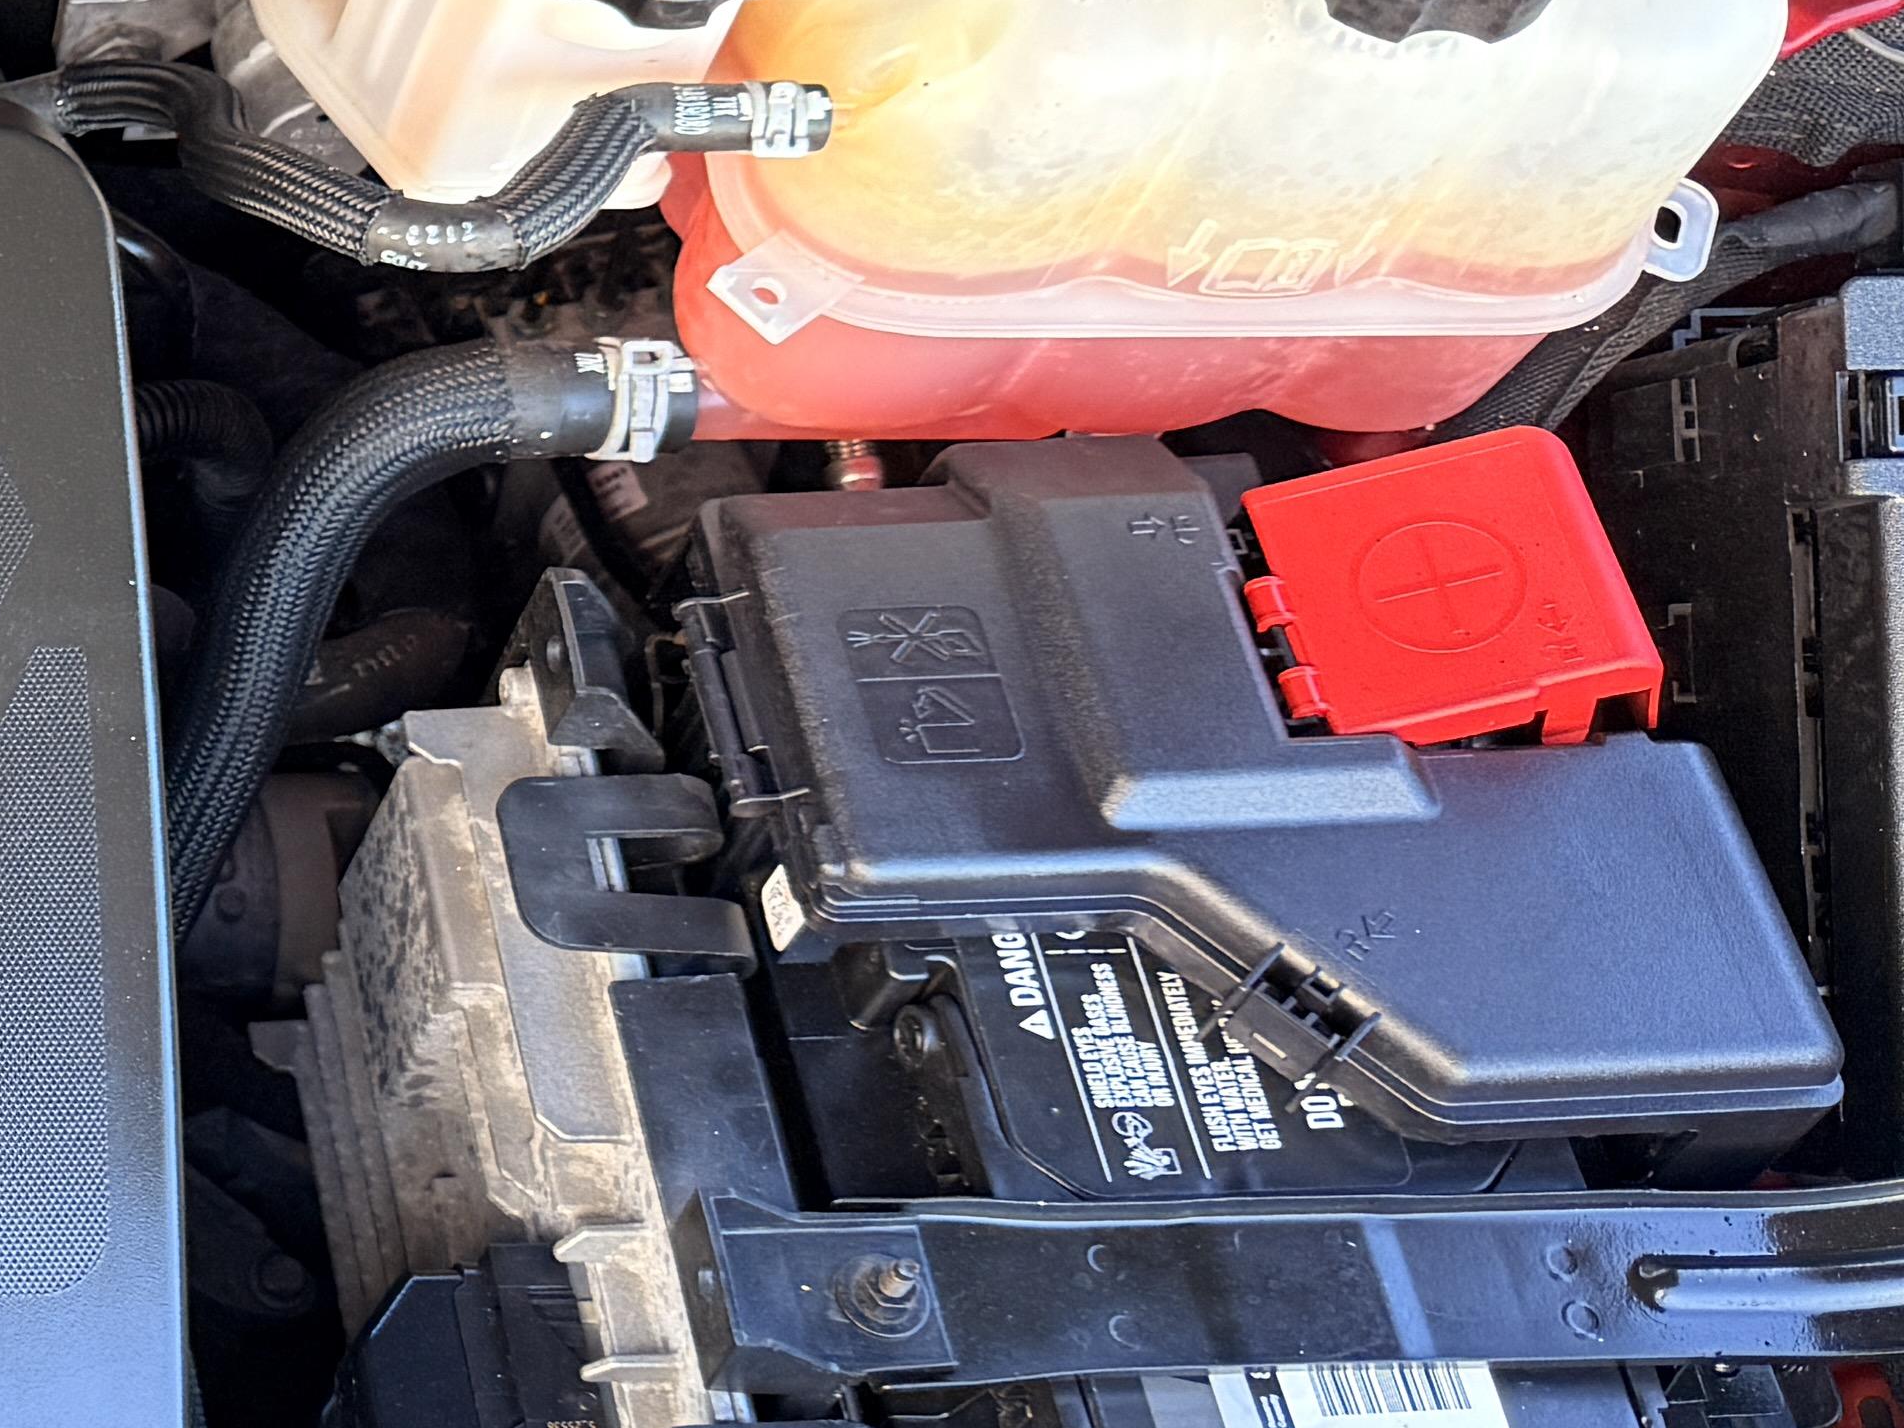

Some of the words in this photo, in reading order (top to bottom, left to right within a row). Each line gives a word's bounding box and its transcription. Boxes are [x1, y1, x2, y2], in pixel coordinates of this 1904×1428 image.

[1091, 963, 1131, 1033] BLINDNESS
[1158, 971, 1207, 1064] IMMEDIATELY
[1070, 1026, 1099, 1060] EYES
[1113, 1035, 1145, 1077] CAUSE
[1082, 1061, 1115, 1108] SHIELD
[1095, 1037, 1135, 1107] EXPLOSIVE
[1128, 1078, 1154, 1107] CAN
[1188, 1065, 1220, 1104] EYES
[1210, 1056, 1244, 1110] WATER.
[1232, 1055, 1271, 1119] MEDICAL
[1150, 1087, 1174, 1106] OR
[1201, 1105, 1237, 1151] FLUSH
[1227, 1112, 1258, 1150] WITH
[1252, 1121, 1282, 1149] GET
